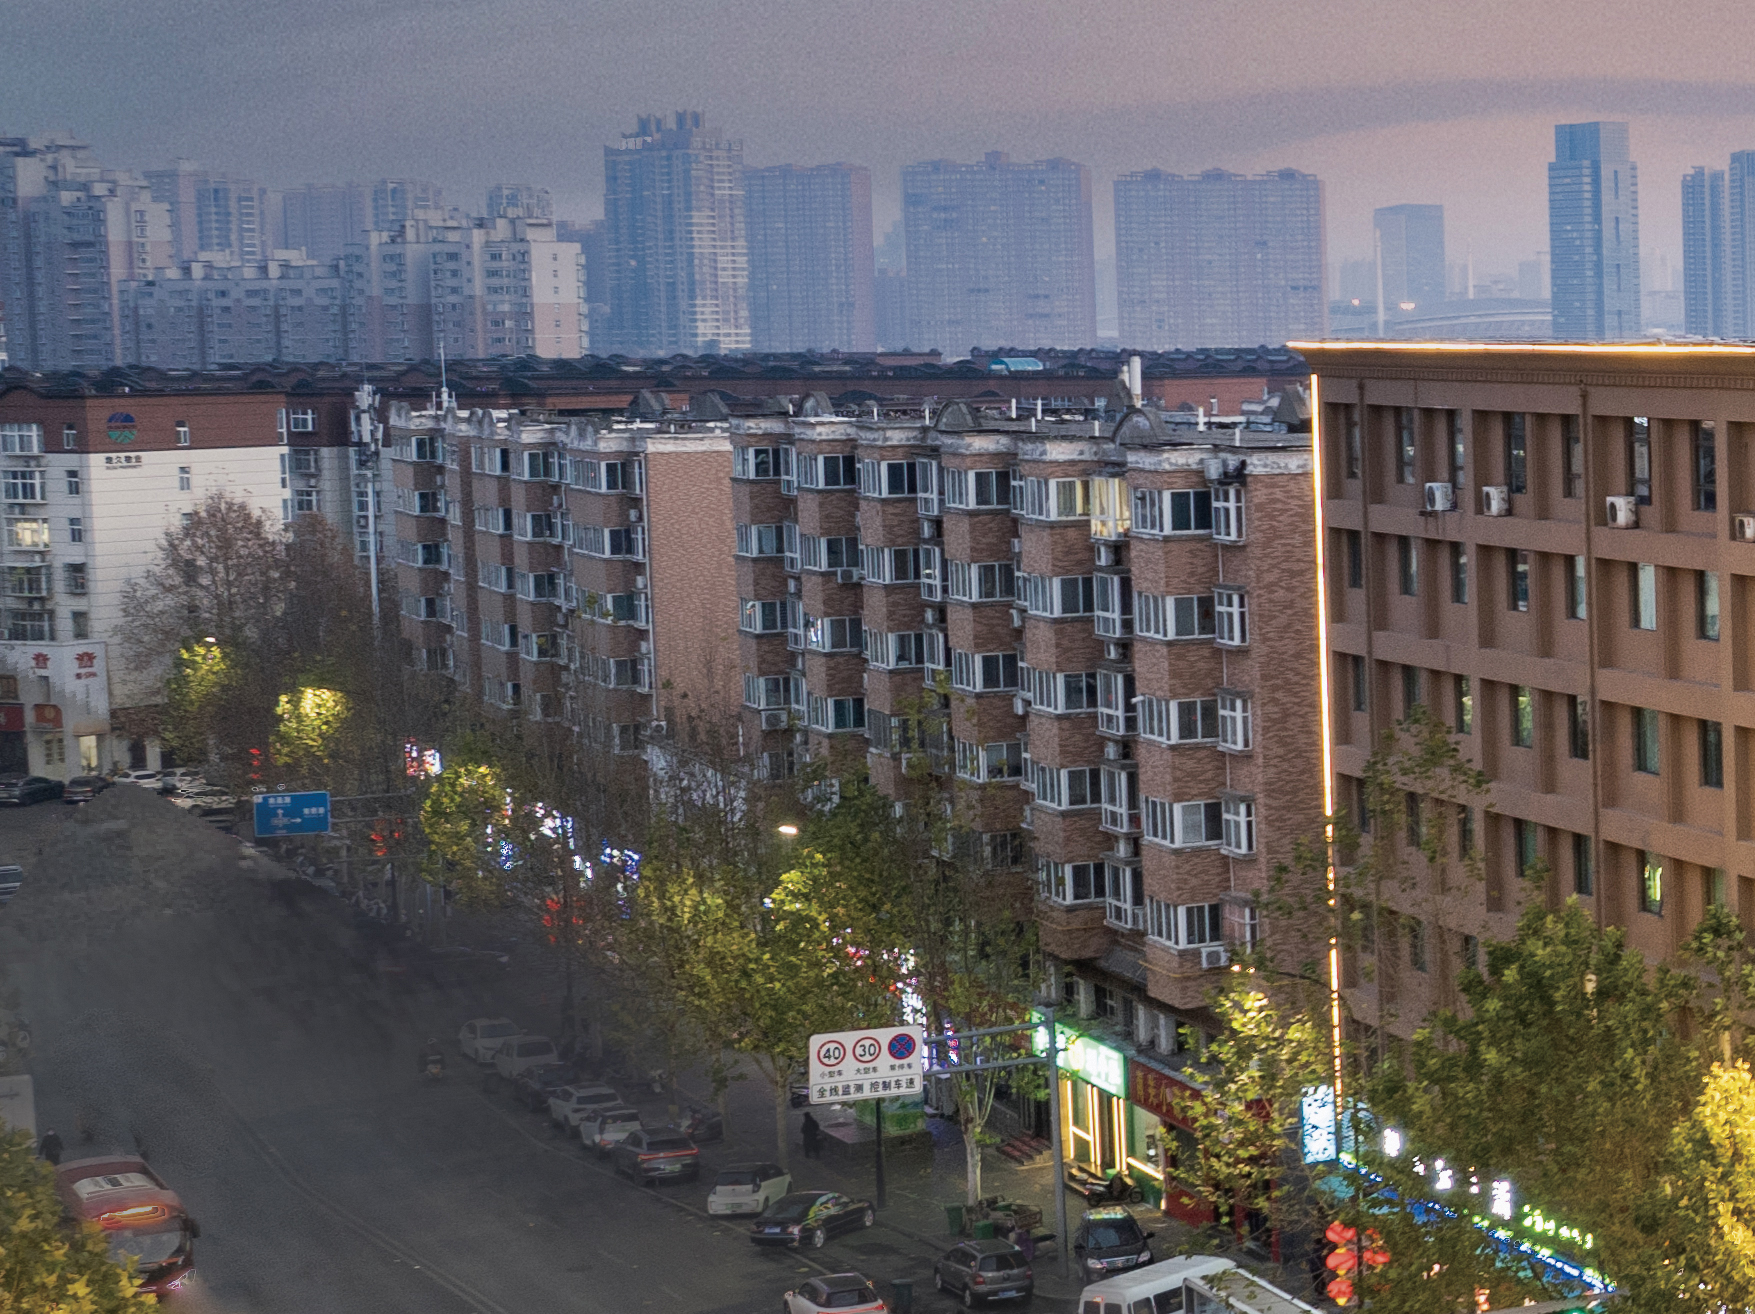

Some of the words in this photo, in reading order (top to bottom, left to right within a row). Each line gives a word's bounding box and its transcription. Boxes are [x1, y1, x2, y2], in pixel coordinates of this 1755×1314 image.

[822, 1046, 842, 1061] 40
[858, 1043, 877, 1058] 30
[819, 1070, 844, 1079] 小型车
[854, 1066, 879, 1075] 大型车
[816, 1082, 865, 1099] 全线监测
[869, 1077, 916, 1094] 控制车速
